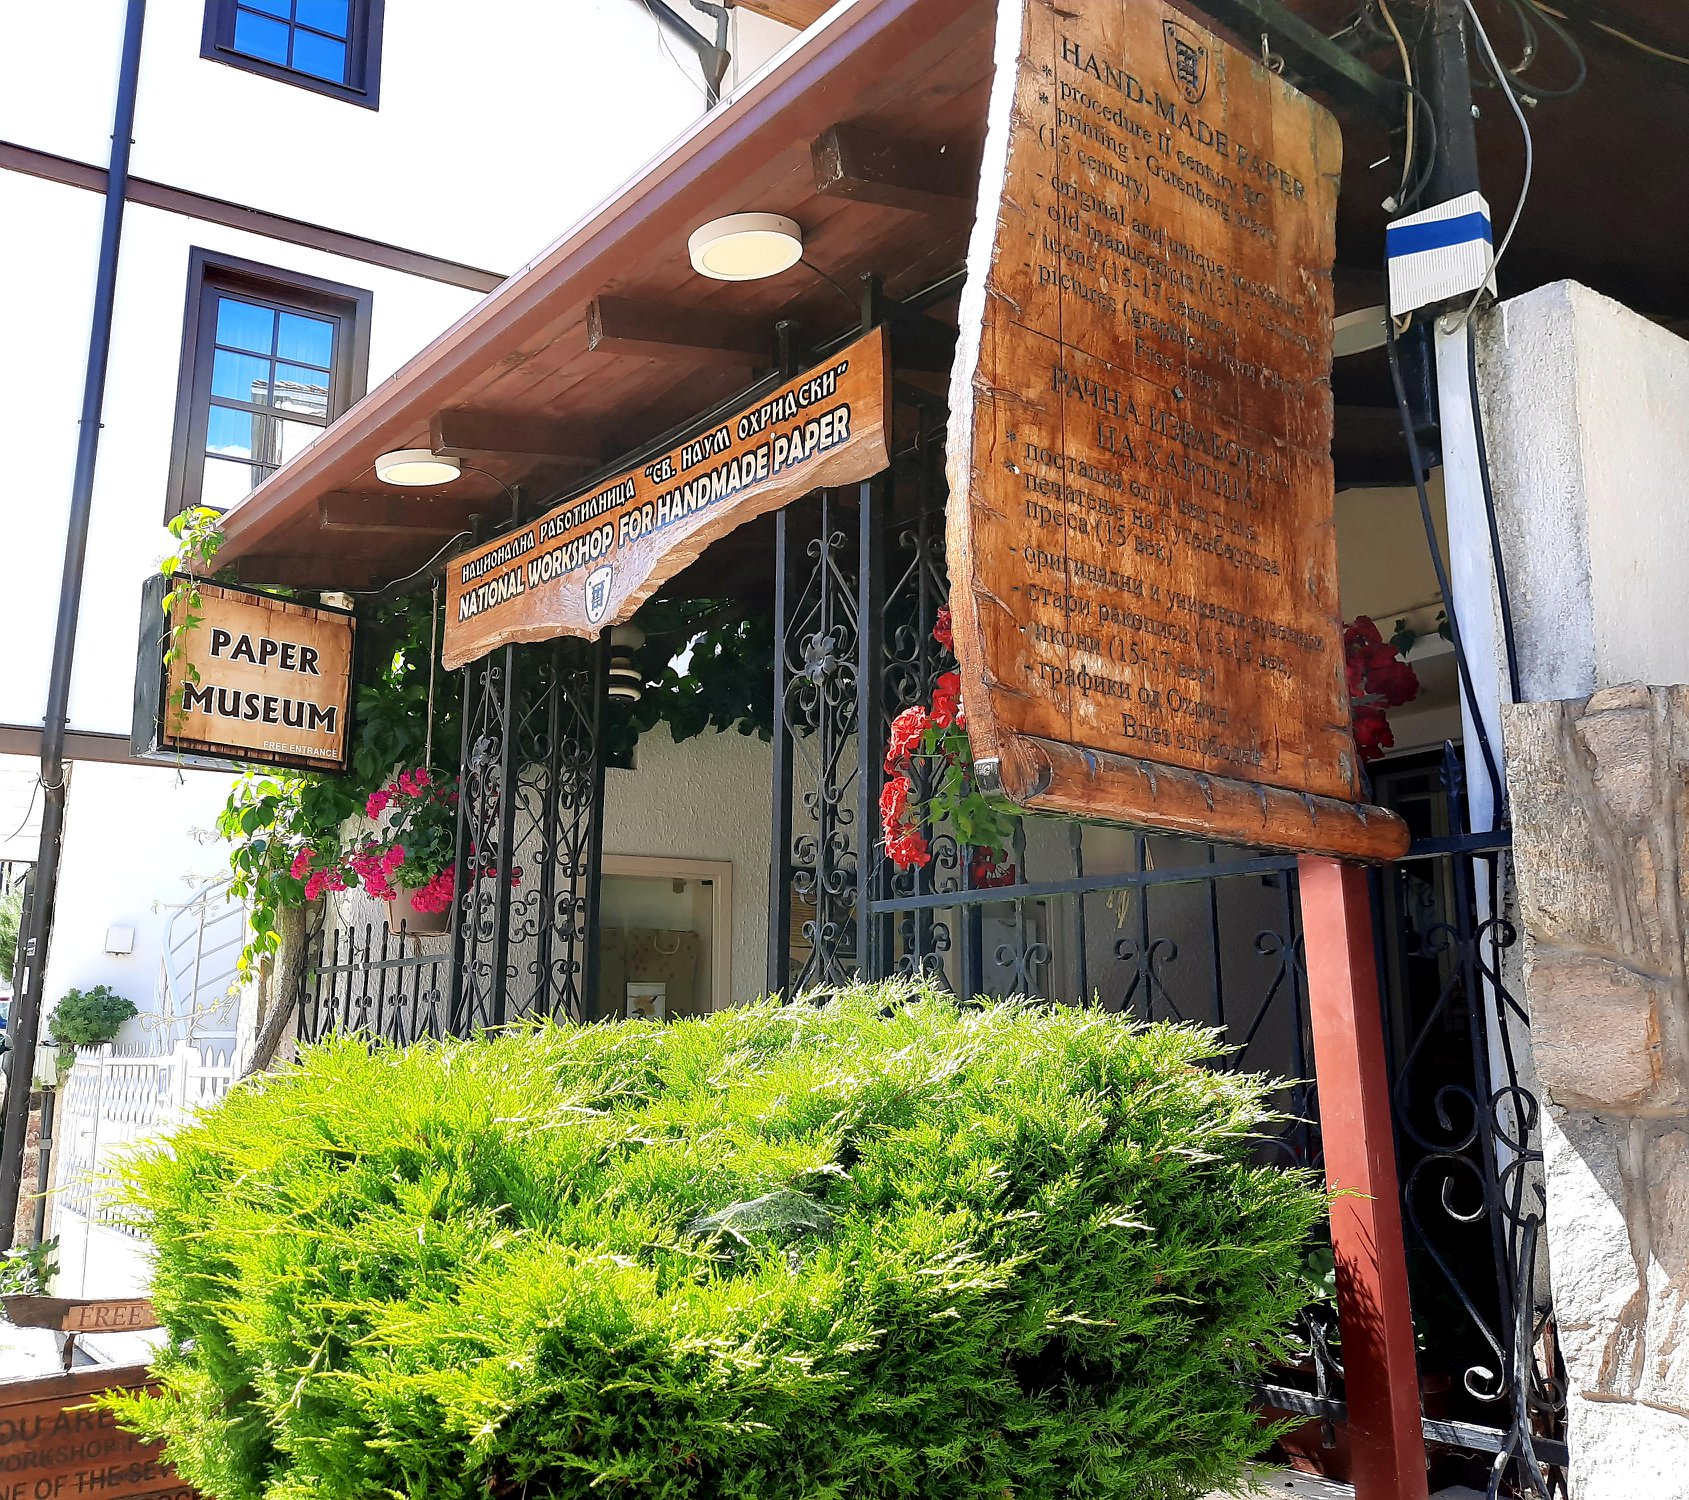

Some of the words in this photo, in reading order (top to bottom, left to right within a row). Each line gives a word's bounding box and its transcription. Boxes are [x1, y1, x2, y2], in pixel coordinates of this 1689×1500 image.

[1059, 34, 1228, 158] HAND-MADE
[1236, 143, 1304, 204] PAPER
[1059, 78, 1151, 145] procedure
[1176, 148, 1236, 199] century
[1038, 120, 1069, 156] (15
[1077, 147, 1150, 207] century)
[1056, 106, 1127, 164] printing
[1146, 153, 1229, 221] Gutenberg
[1047, 203, 1079, 234] old
[1087, 224, 1193, 293] manuscripts
[1051, 175, 1126, 227] original
[1132, 218, 1161, 245] and
[1170, 239, 1225, 279] unique
[1038, 263, 1116, 313] pictures
[1043, 230, 1096, 273] icons
[1102, 257, 1161, 304] (15-17
[1135, 337, 1172, 370] Free
[1051, 364, 1140, 425] РАЧНА
[1149, 405, 1289, 487] ИЗРАБОТКА
[1024, 472, 1125, 523] печатење
[1131, 509, 1154, 532] на
[1026, 441, 1122, 491] постапка
[1129, 479, 1151, 503] од
[1144, 440, 1259, 509] ХАРТИЈА
[459, 565, 525, 622] NATIONAL
[529, 524, 614, 589] WORKSHOP
[619, 504, 654, 548] FOR
[657, 446, 768, 527] HANDMADE
[774, 407, 848, 473] PAPER
[1025, 499, 1087, 535] преса
[1095, 515, 1128, 548] (15
[1134, 536, 1173, 568] век)
[1023, 544, 1144, 597] оригинални
[1027, 584, 1091, 621] стари
[1098, 603, 1189, 644] ракописи
[1035, 621, 1101, 655] икони
[209, 628, 321, 676] PAPER
[181, 680, 338, 734] MUSEUM
[1038, 660, 1131, 700] графики
[1138, 686, 1160, 709] од
[263, 741, 288, 751] FREE
[289, 744, 338, 758] ENTRANCE
[1121, 712, 1171, 747] Влез
[78, 1306, 143, 1327] FREE
[51, 1410, 115, 1436] ARE
[35, 1475, 68, 1499] OF
[75, 1465, 121, 1493] THE
